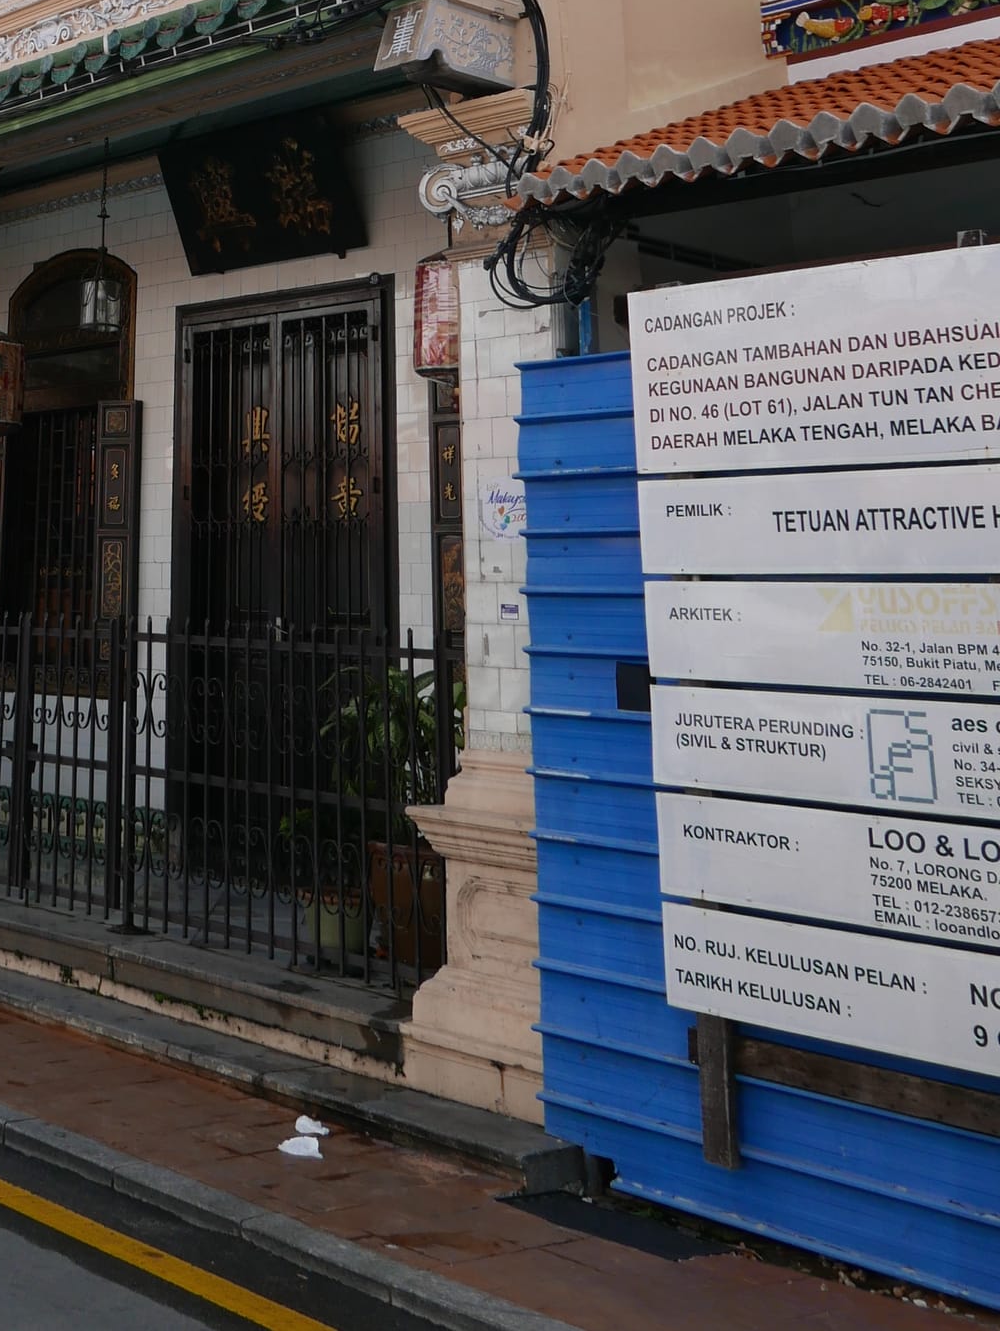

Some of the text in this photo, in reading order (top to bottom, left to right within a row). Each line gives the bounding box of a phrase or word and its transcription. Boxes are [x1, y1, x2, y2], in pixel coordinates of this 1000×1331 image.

[645, 310, 722, 333] CADANGAN
[728, 301, 786, 323] PROJEK
[647, 349, 737, 372] CADANGAN
[742, 338, 841, 362] TAMBAHAN
[848, 333, 887, 352] DAN
[648, 352, 1000, 397] KEGUNAAN BANGUNAN DARIPADA KED
[650, 408, 664, 423] DI
[670, 406, 696, 422] NO.
[701, 404, 719, 419] 46
[724, 400, 762, 421] (LOT
[767, 397, 797, 417] 61),
[803, 392, 863, 412] JALAN
[868, 389, 908, 407] TUN
[914, 385, 954, 404] TAN
[651, 414, 1000, 450] DAERAH MELAKA TENGAH, MELAKA B
[666, 503, 723, 517] PEMILIK
[772, 509, 850, 532] TETUAN
[855, 505, 986, 531] ATTRACTIVE
[669, 607, 732, 621] ARKITEK
[861, 640, 881, 651] No.
[885, 641, 916, 655] 32-1,
[919, 643, 953, 654] Jalan
[957, 644, 988, 655] BPM
[862, 655, 902, 668] 75150,
[906, 657, 940, 669] Bukit
[943, 658, 981, 672] Piatu,
[864, 674, 888, 686] TEL
[900, 676, 972, 690] 06-2842401
[675, 713, 755, 731] JURUTERA
[759, 719, 854, 739] PERUNDING
[951, 717, 988, 733] aes
[676, 732, 826, 762] (SIVIL & STRUKTUR)
[952, 742, 993, 755] civil &
[954, 759, 976, 771] No.
[957, 792, 985, 806] TEL
[683, 824, 790, 851] KONTRAKTOR
[868, 827, 926, 854] LOO
[935, 834, 954, 858] &
[869, 856, 893, 871] No.
[897, 860, 910, 875] 7,
[914, 862, 982, 883] LORONG
[870, 873, 987, 901] 75200 MELAKA.
[872, 893, 901, 910] TEL
[874, 909, 921, 929] EMAIL
[674, 934, 701, 953] NO.
[705, 939, 741, 960] RUJ.
[745, 946, 849, 980] KELULUSAN
[854, 966, 916, 992] PELAN
[675, 968, 733, 993] TARIKH
[738, 980, 841, 1016] KELULUSAN
[973, 1024, 989, 1047] 9
